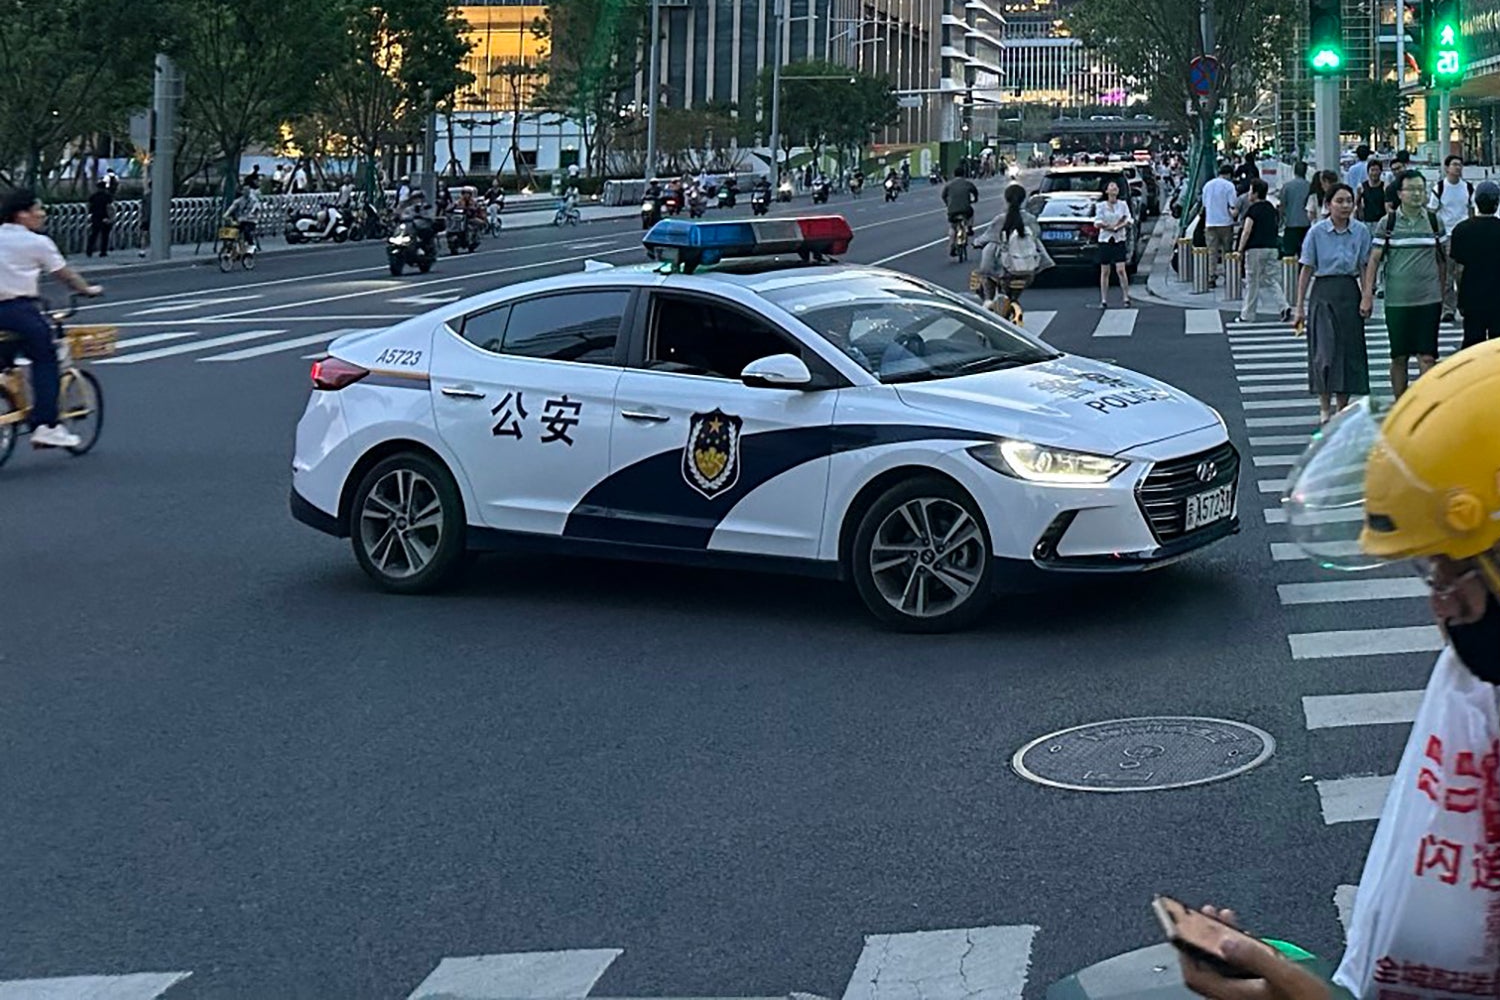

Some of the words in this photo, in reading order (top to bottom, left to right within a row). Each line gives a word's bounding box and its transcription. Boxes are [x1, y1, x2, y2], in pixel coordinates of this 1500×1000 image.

[1437, 51, 1459, 74] 20
[376, 348, 423, 366] A5723
[1085, 388, 1166, 415] POLIC
[491, 391, 582, 447] 公安
